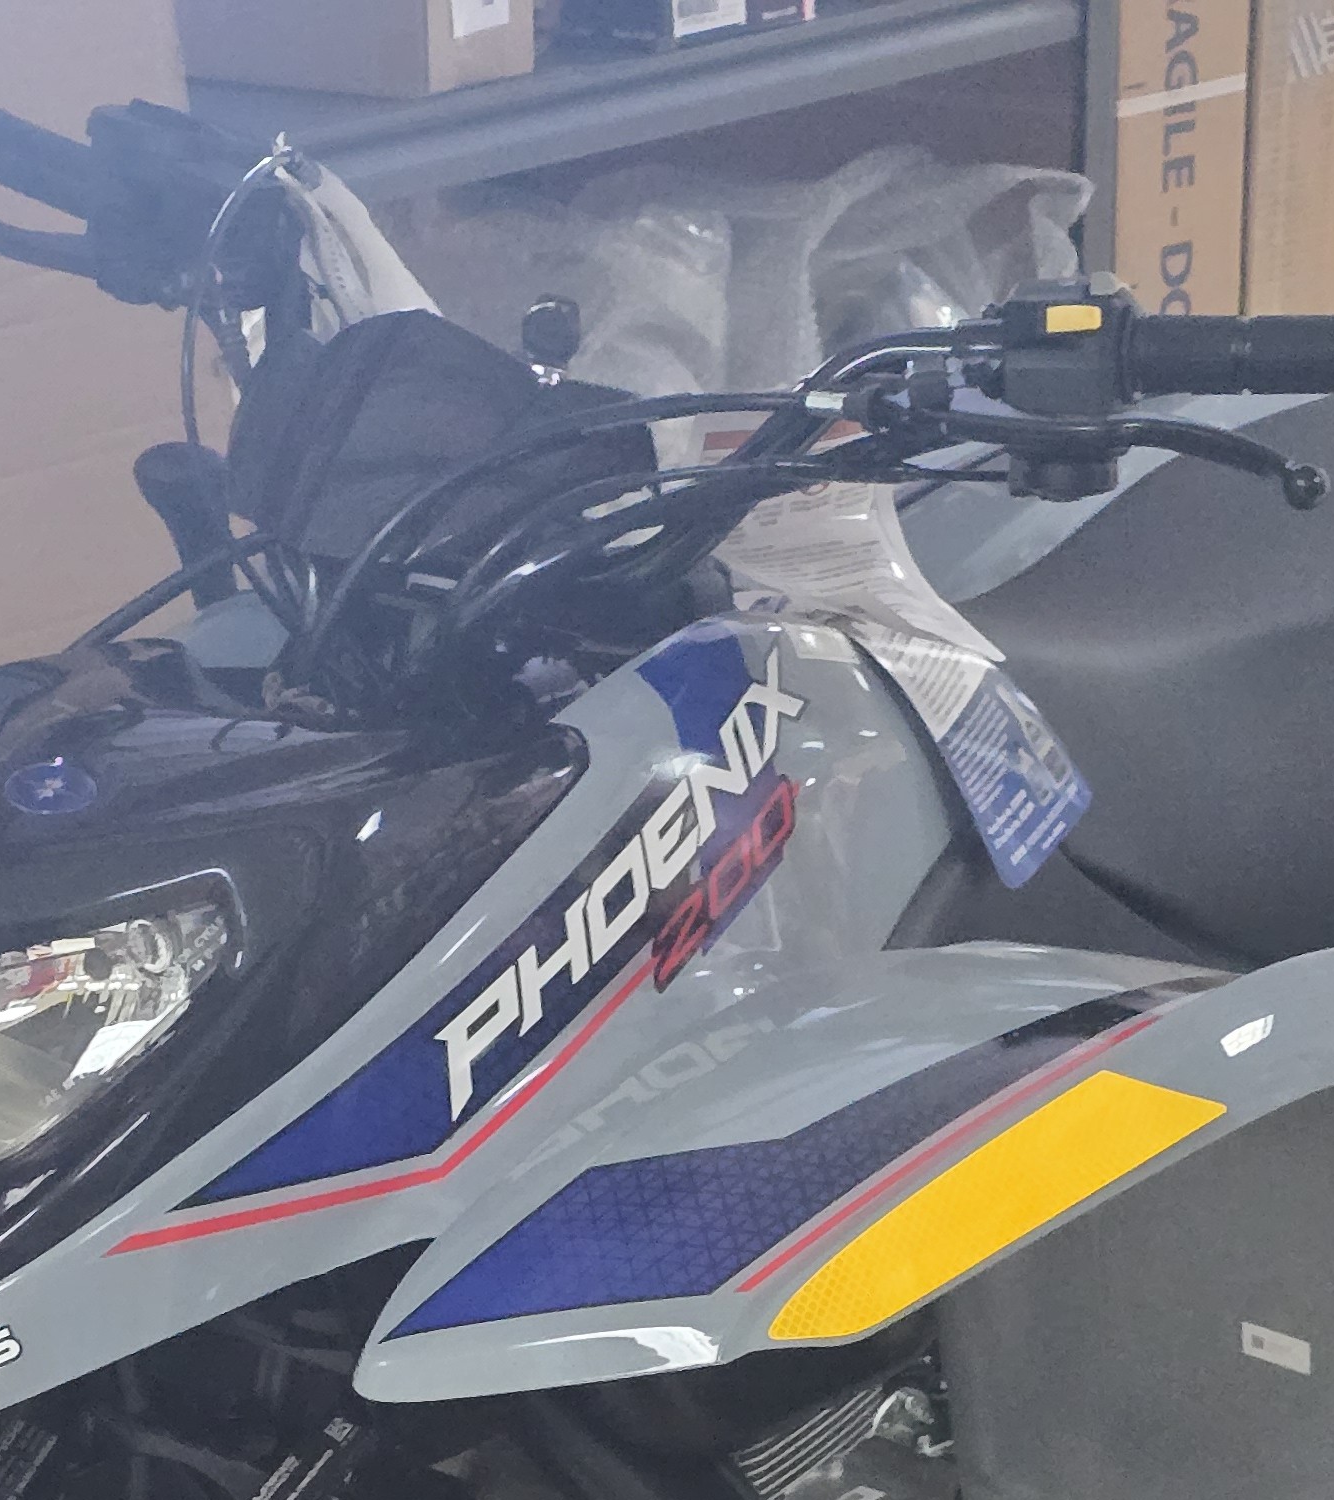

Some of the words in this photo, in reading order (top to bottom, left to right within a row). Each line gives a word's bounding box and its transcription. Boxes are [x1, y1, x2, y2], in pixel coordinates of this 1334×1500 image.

[1162, 0, 1200, 193] AGILE
[433, 645, 806, 1123] PHOENIX
[652, 773, 799, 992] 200
